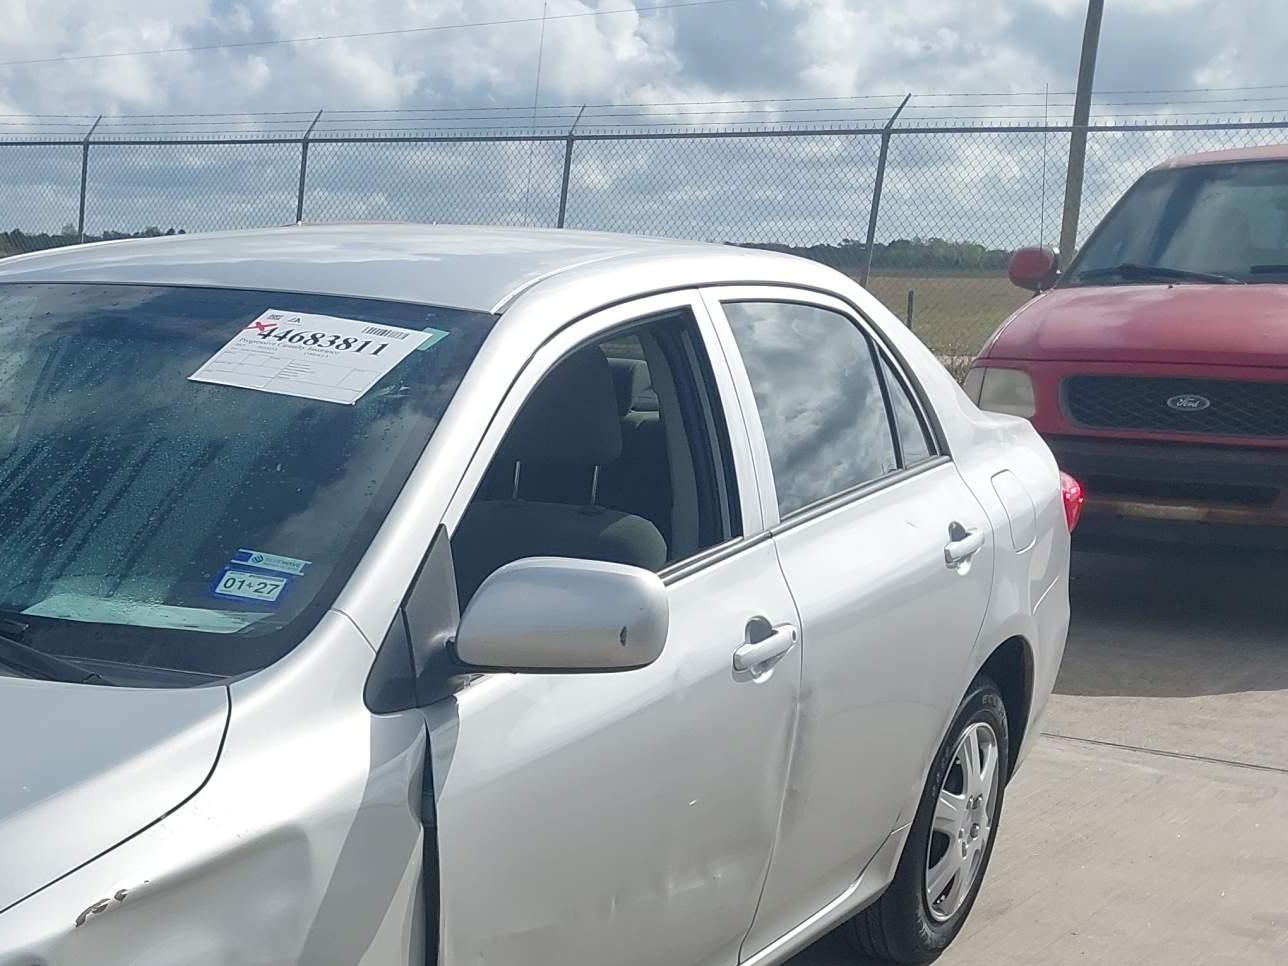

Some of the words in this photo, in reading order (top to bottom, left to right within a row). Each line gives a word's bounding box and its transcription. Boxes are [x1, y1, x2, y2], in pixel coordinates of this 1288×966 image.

[257, 326, 390, 356] 44683811
[223, 578, 245, 590] 01
[253, 582, 281, 595] 27
